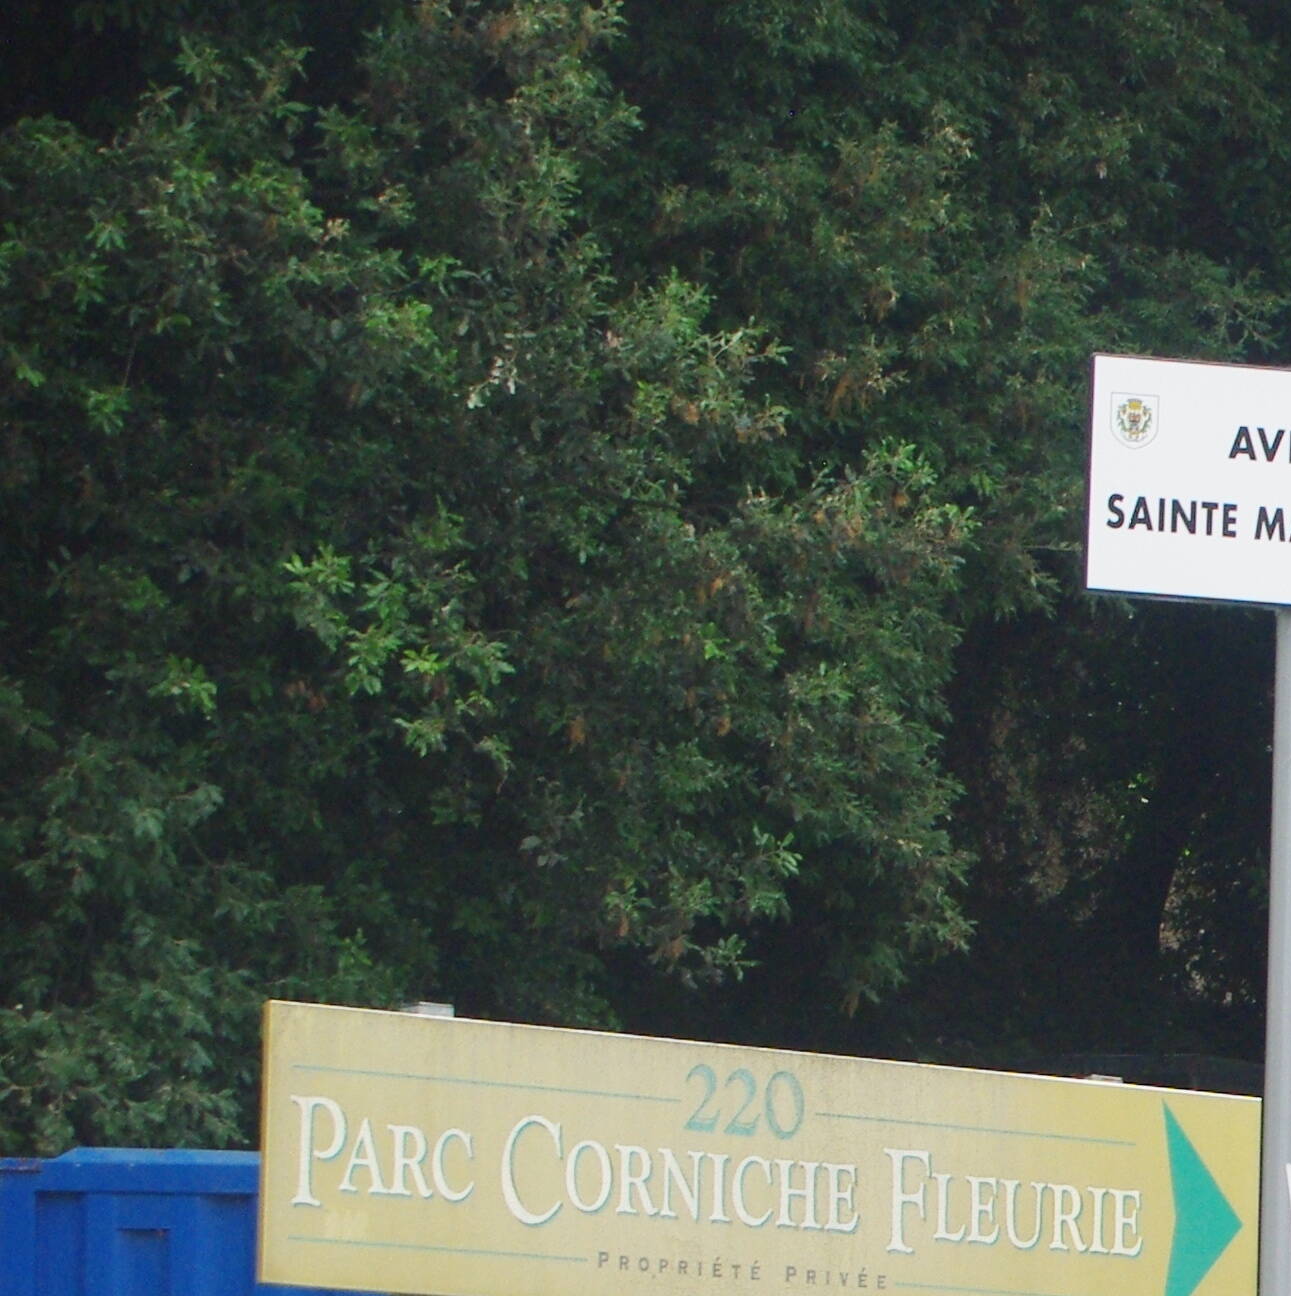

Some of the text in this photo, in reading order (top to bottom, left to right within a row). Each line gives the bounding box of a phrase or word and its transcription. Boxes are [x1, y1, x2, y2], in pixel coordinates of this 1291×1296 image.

[1106, 493, 1238, 539] SAINTE
[682, 1063, 804, 1141] 220
[288, 1094, 1145, 1259] PARC CORNICHE FLEURIE
[597, 1251, 888, 1290] PROPRIÉTÉ PRIVÉE
